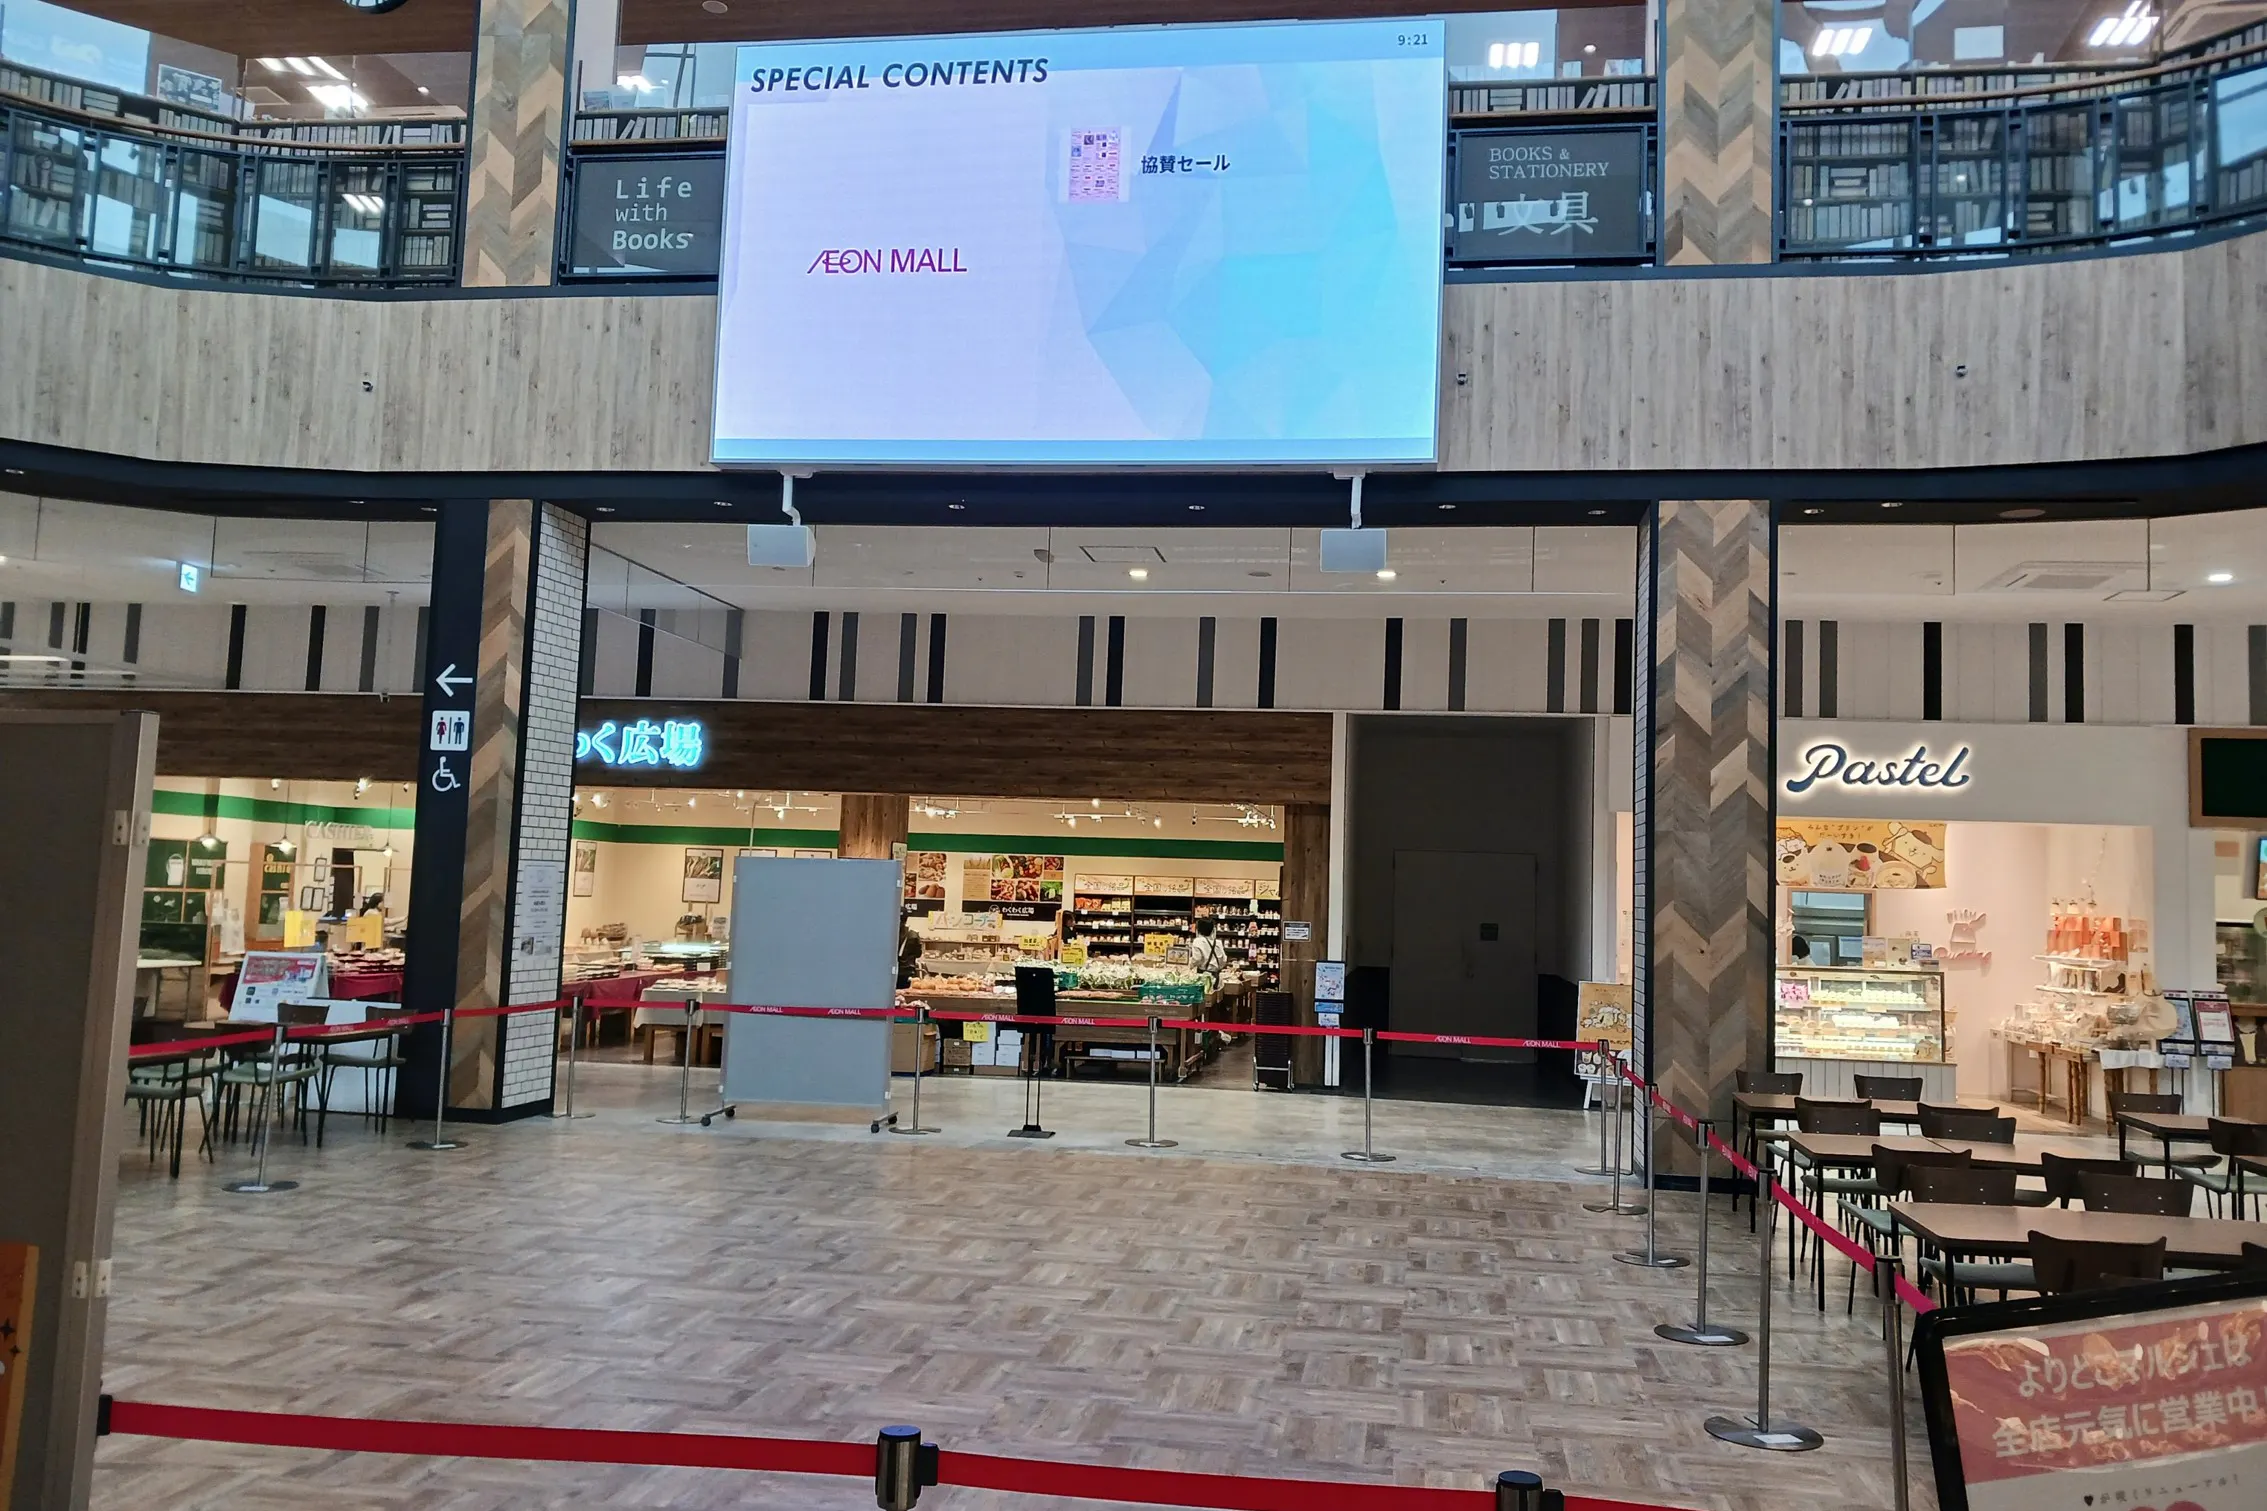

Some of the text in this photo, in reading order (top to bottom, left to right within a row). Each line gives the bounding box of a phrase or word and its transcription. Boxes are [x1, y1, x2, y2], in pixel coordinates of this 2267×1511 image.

[1397, 34, 1428, 46] 9:21
[750, 57, 1048, 92] SPECIAL CONTENTS
[1141, 154, 1231, 174] 協賛セール
[1489, 146, 1571, 162] BOOKS &
[1489, 161, 1609, 180] STATIONERY
[616, 176, 692, 199] Life
[615, 202, 667, 222] with
[1498, 191, 1599, 236] 文具
[612, 228, 690, 250] Books
[890, 248, 968, 273] MALL
[1786, 743, 1970, 793] Pastel
[766, 1006, 783, 1014] MALL
[1453, 1036, 1471, 1044] MALL
[1991, 1384, 2267, 1458] 全店元気に営業中
